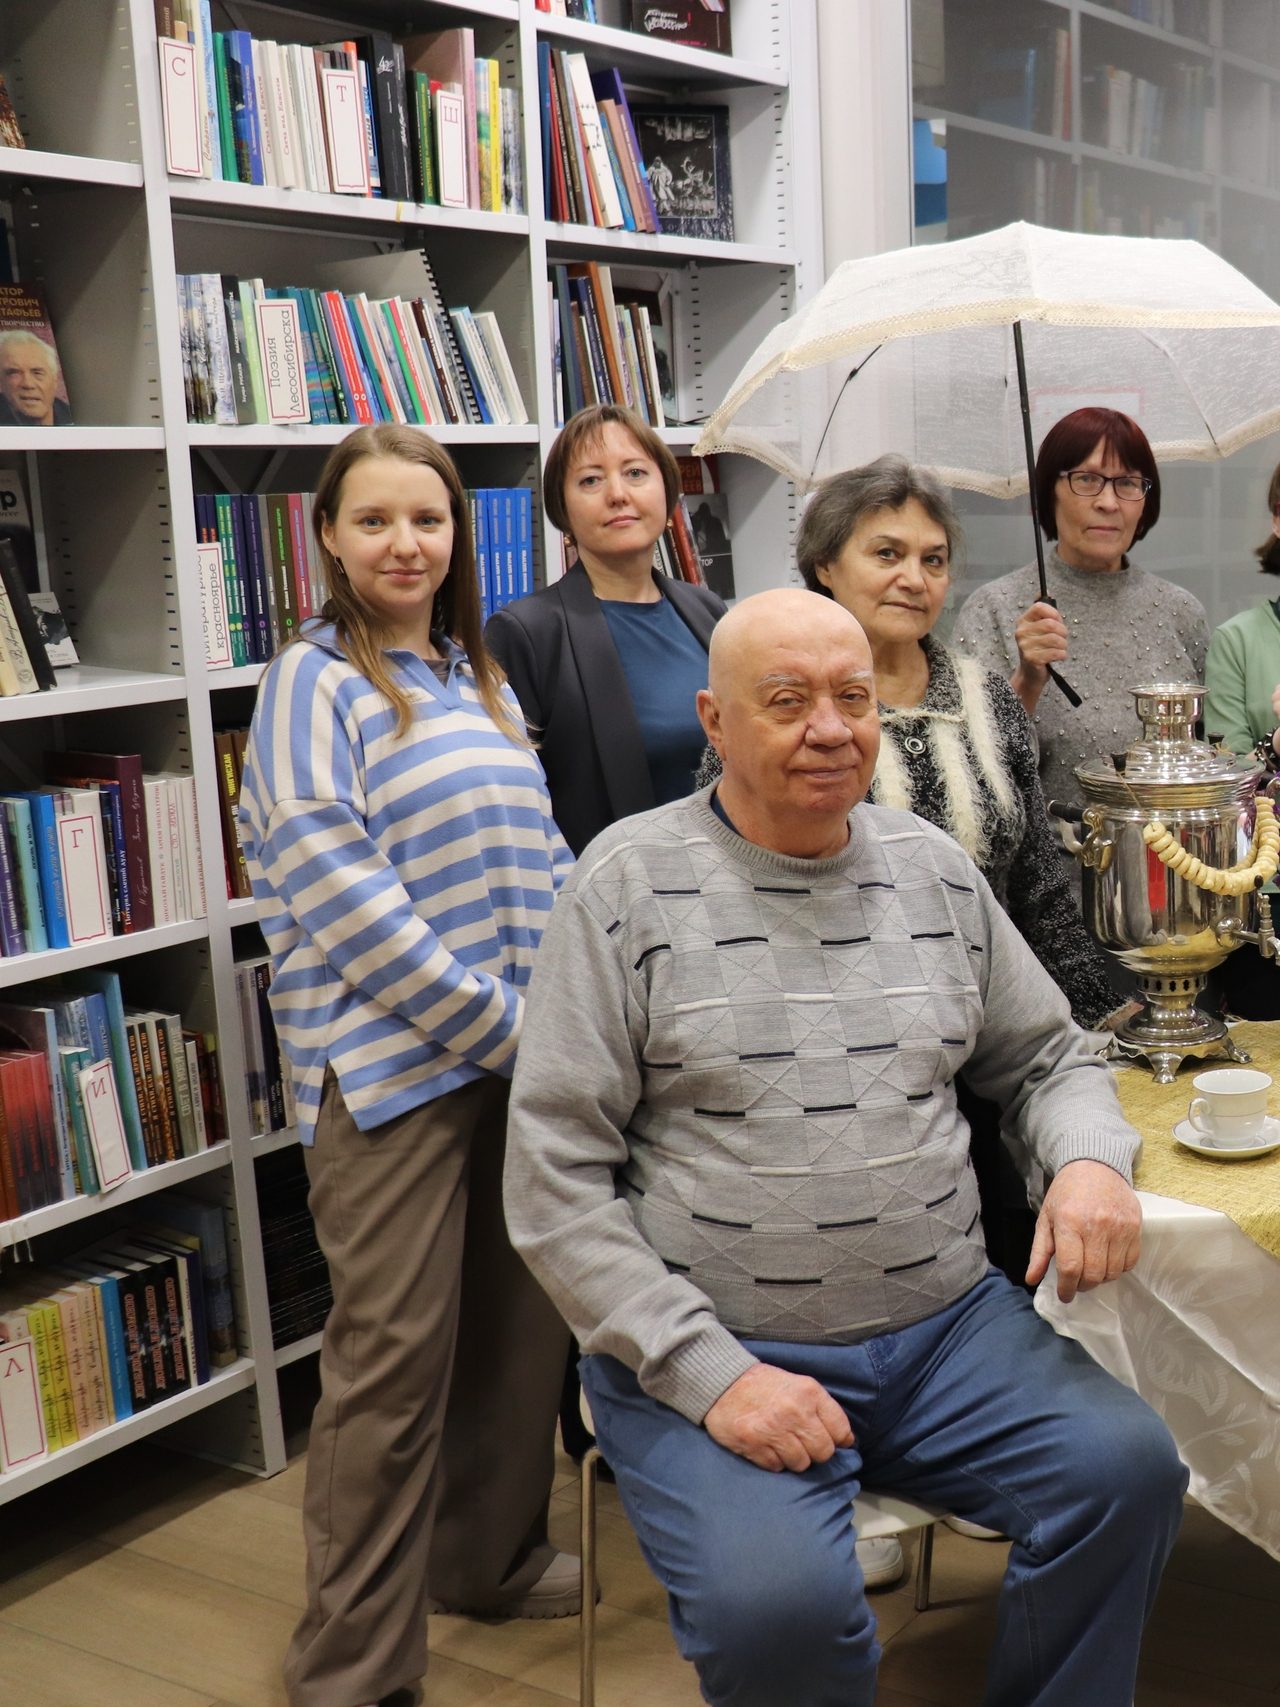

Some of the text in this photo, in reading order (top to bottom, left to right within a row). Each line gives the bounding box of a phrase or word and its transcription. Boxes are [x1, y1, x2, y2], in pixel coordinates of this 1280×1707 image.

[172, 57, 186, 76] С
[336, 85, 347, 102] Т
[444, 105, 458, 123] Ш
[267, 337, 280, 388] Поэзия
[280, 310, 301, 413] Лесосибирска
[209, 563, 225, 649] красноярье
[223, 753, 236, 796] ЧИНГИСХАН
[71, 829, 83, 848] Г
[121, 868, 129, 893] слепой
[123, 894, 132, 925] Потерял
[170, 1026, 184, 1053] ДУШЕ
[175, 1056, 187, 1080] МОЕЙ
[92, 1078, 107, 1099] И
[180, 1093, 192, 1116] СВЕТ
[4, 1357, 25, 1378] Л
